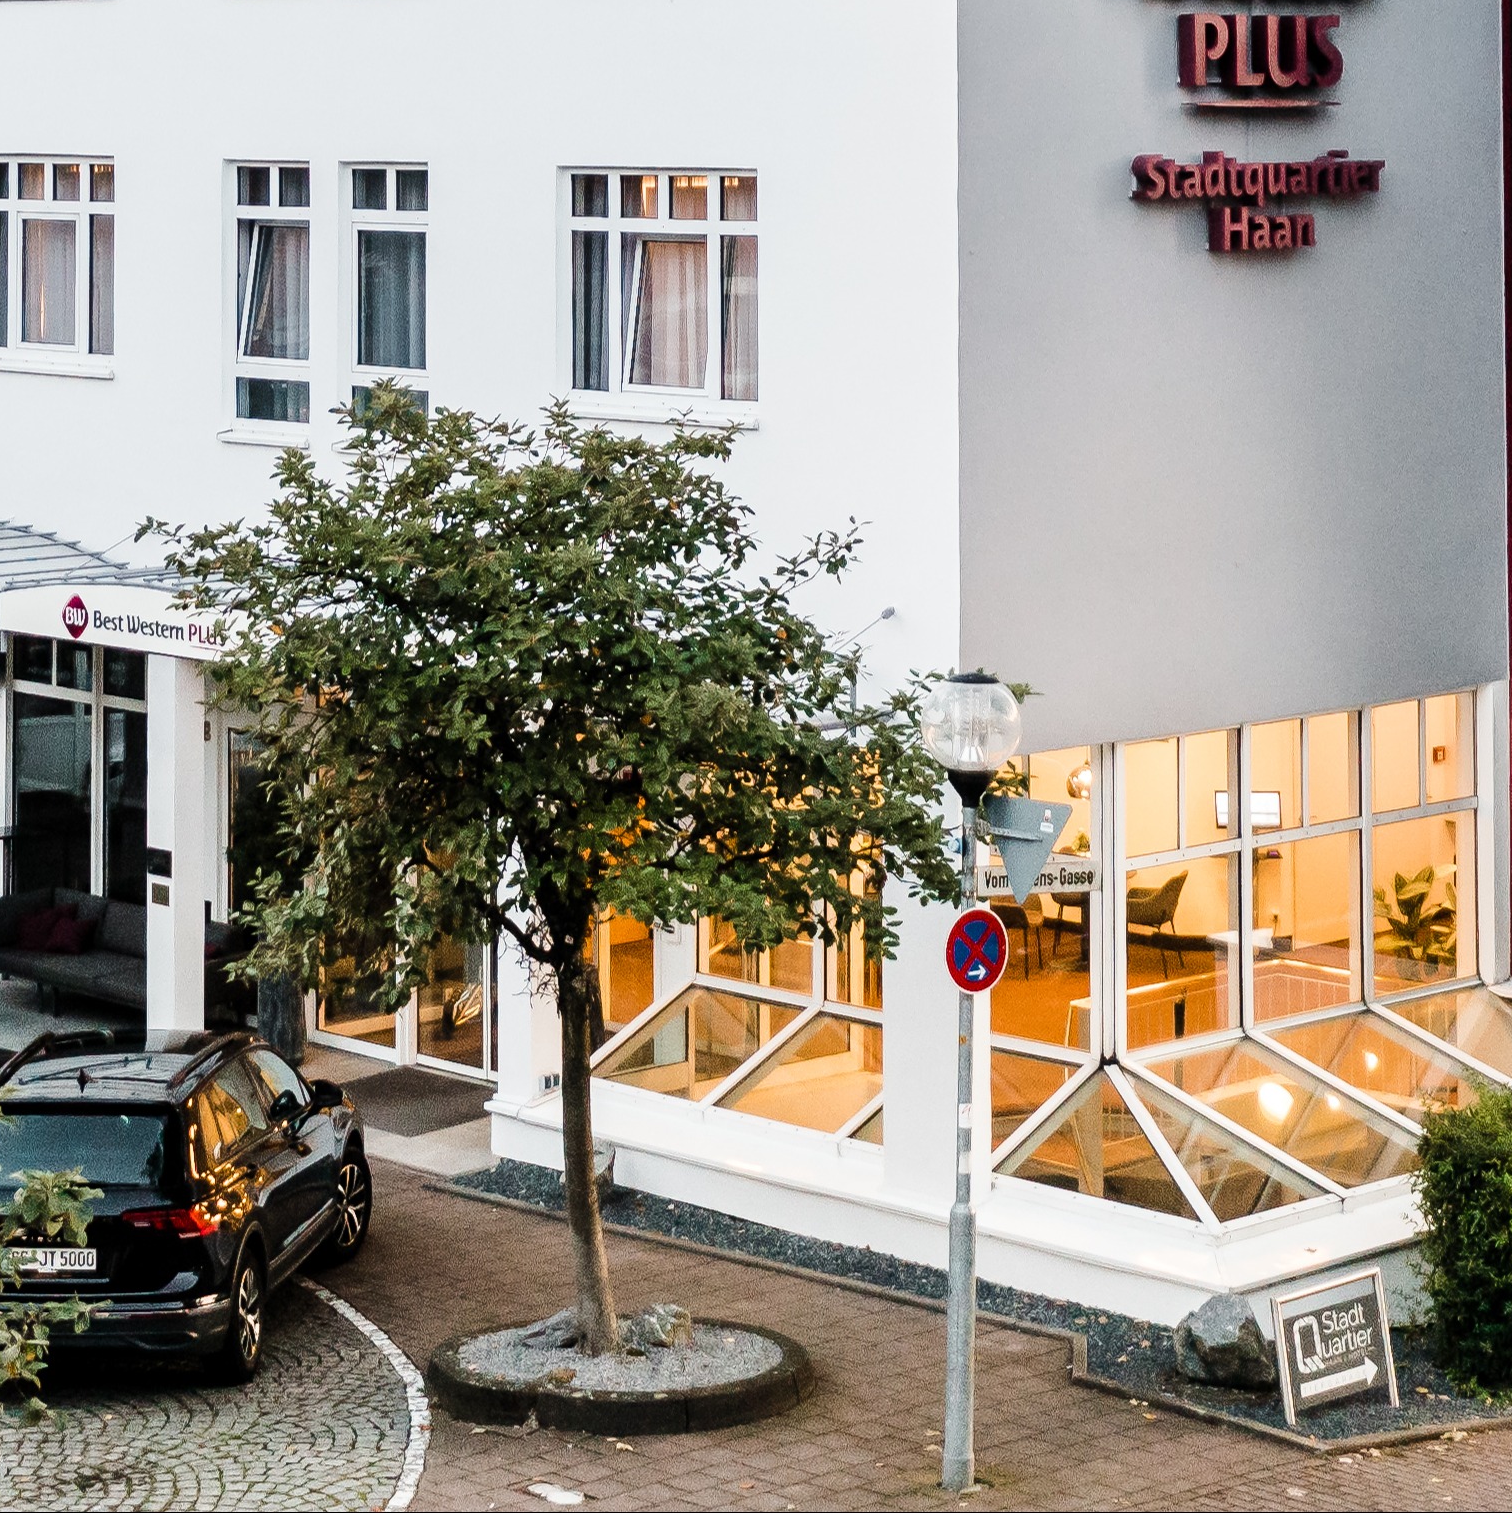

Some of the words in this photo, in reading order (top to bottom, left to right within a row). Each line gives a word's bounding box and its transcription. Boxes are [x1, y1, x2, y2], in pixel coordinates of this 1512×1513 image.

[1179, 13, 1343, 87] PLUS
[1131, 150, 1386, 208] Stadtquartier
[1208, 205, 1316, 252] Haan
[65, 606, 86, 627] BW
[93, 610, 124, 632] Best
[127, 614, 185, 641] Western
[60, 1250, 94, 1267] 5000
[1321, 1302, 1366, 1334] Stadt
